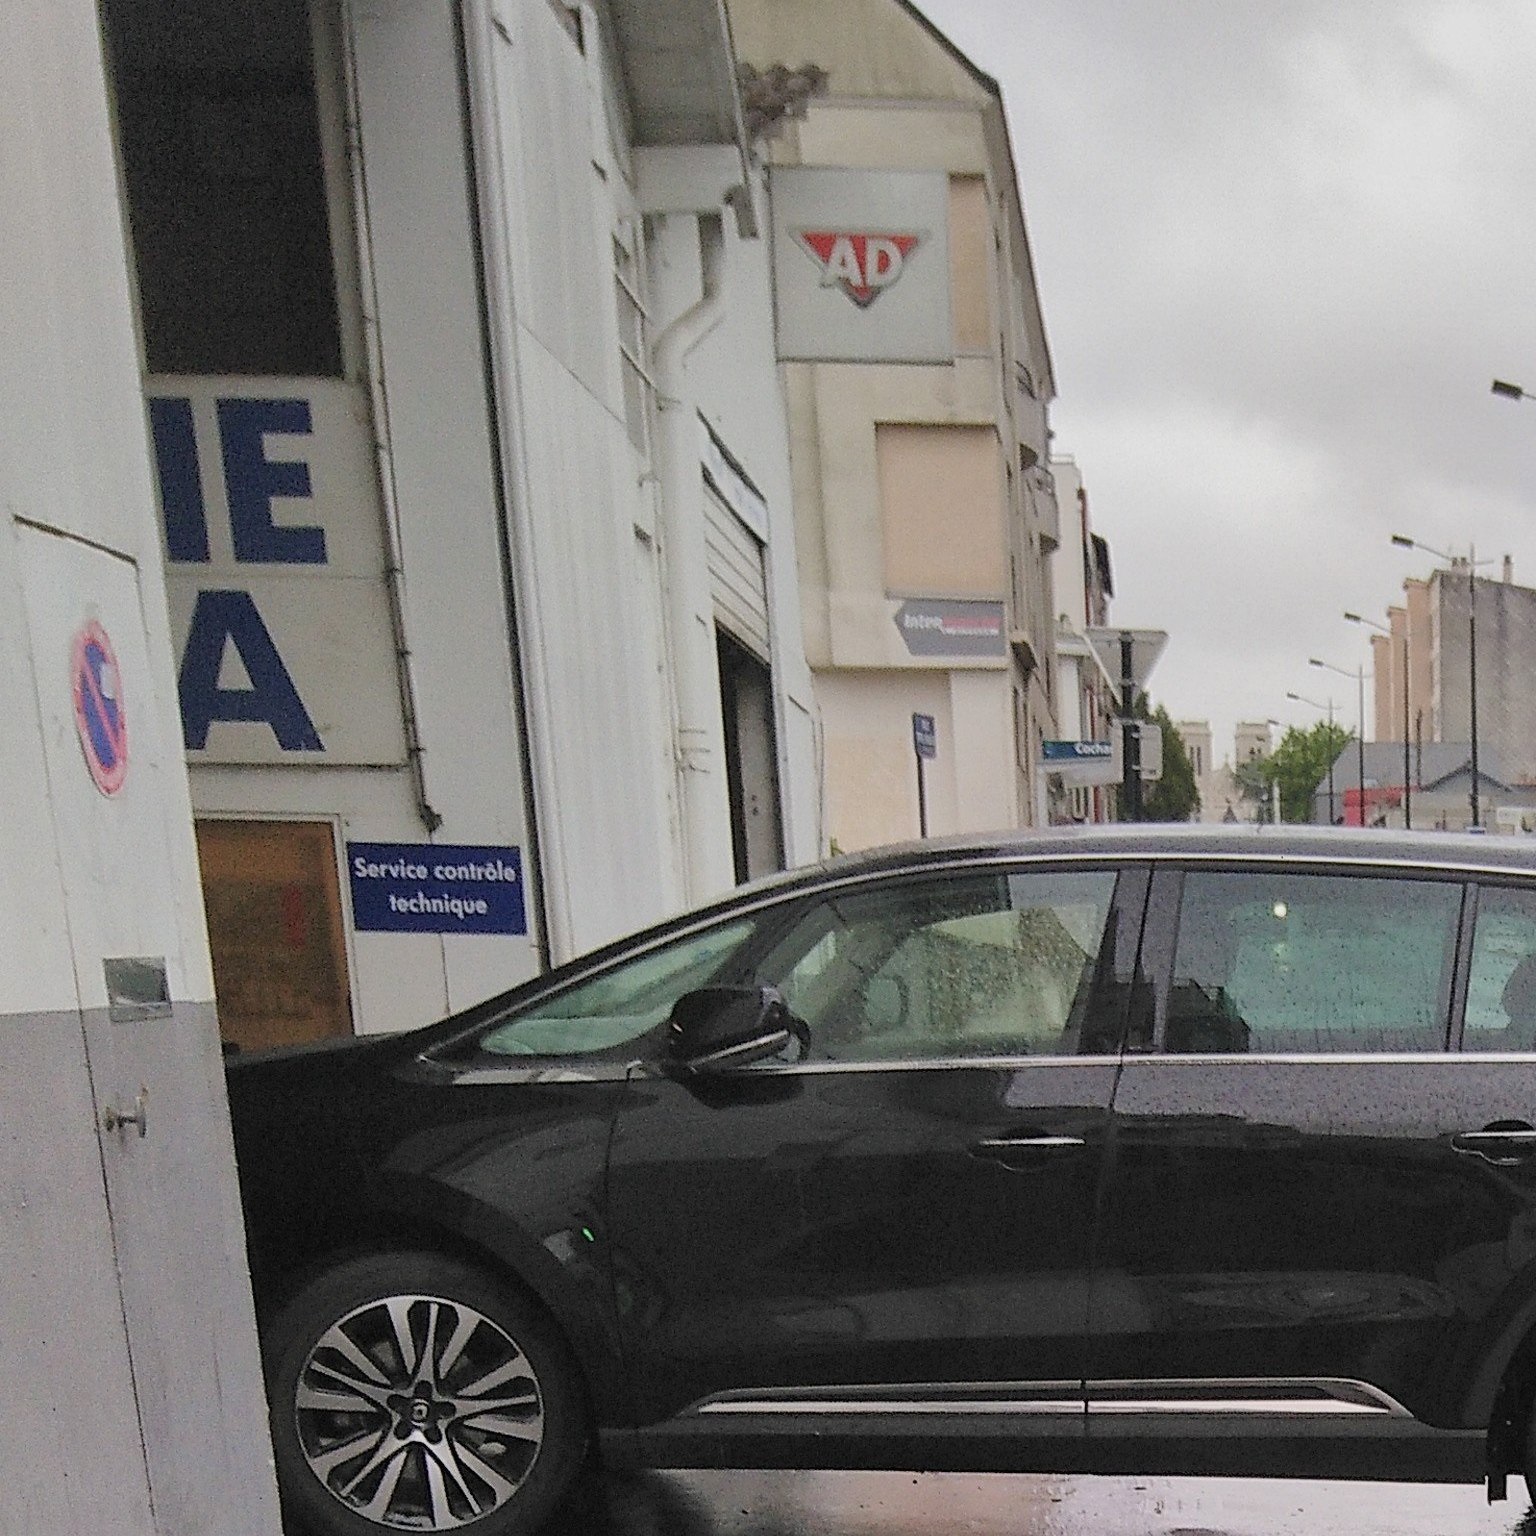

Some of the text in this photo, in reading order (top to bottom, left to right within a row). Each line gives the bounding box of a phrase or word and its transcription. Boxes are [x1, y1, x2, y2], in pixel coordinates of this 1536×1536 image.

[820, 237, 903, 288] AD
[354, 857, 516, 883] Service contrôle
[389, 891, 488, 920] technique
